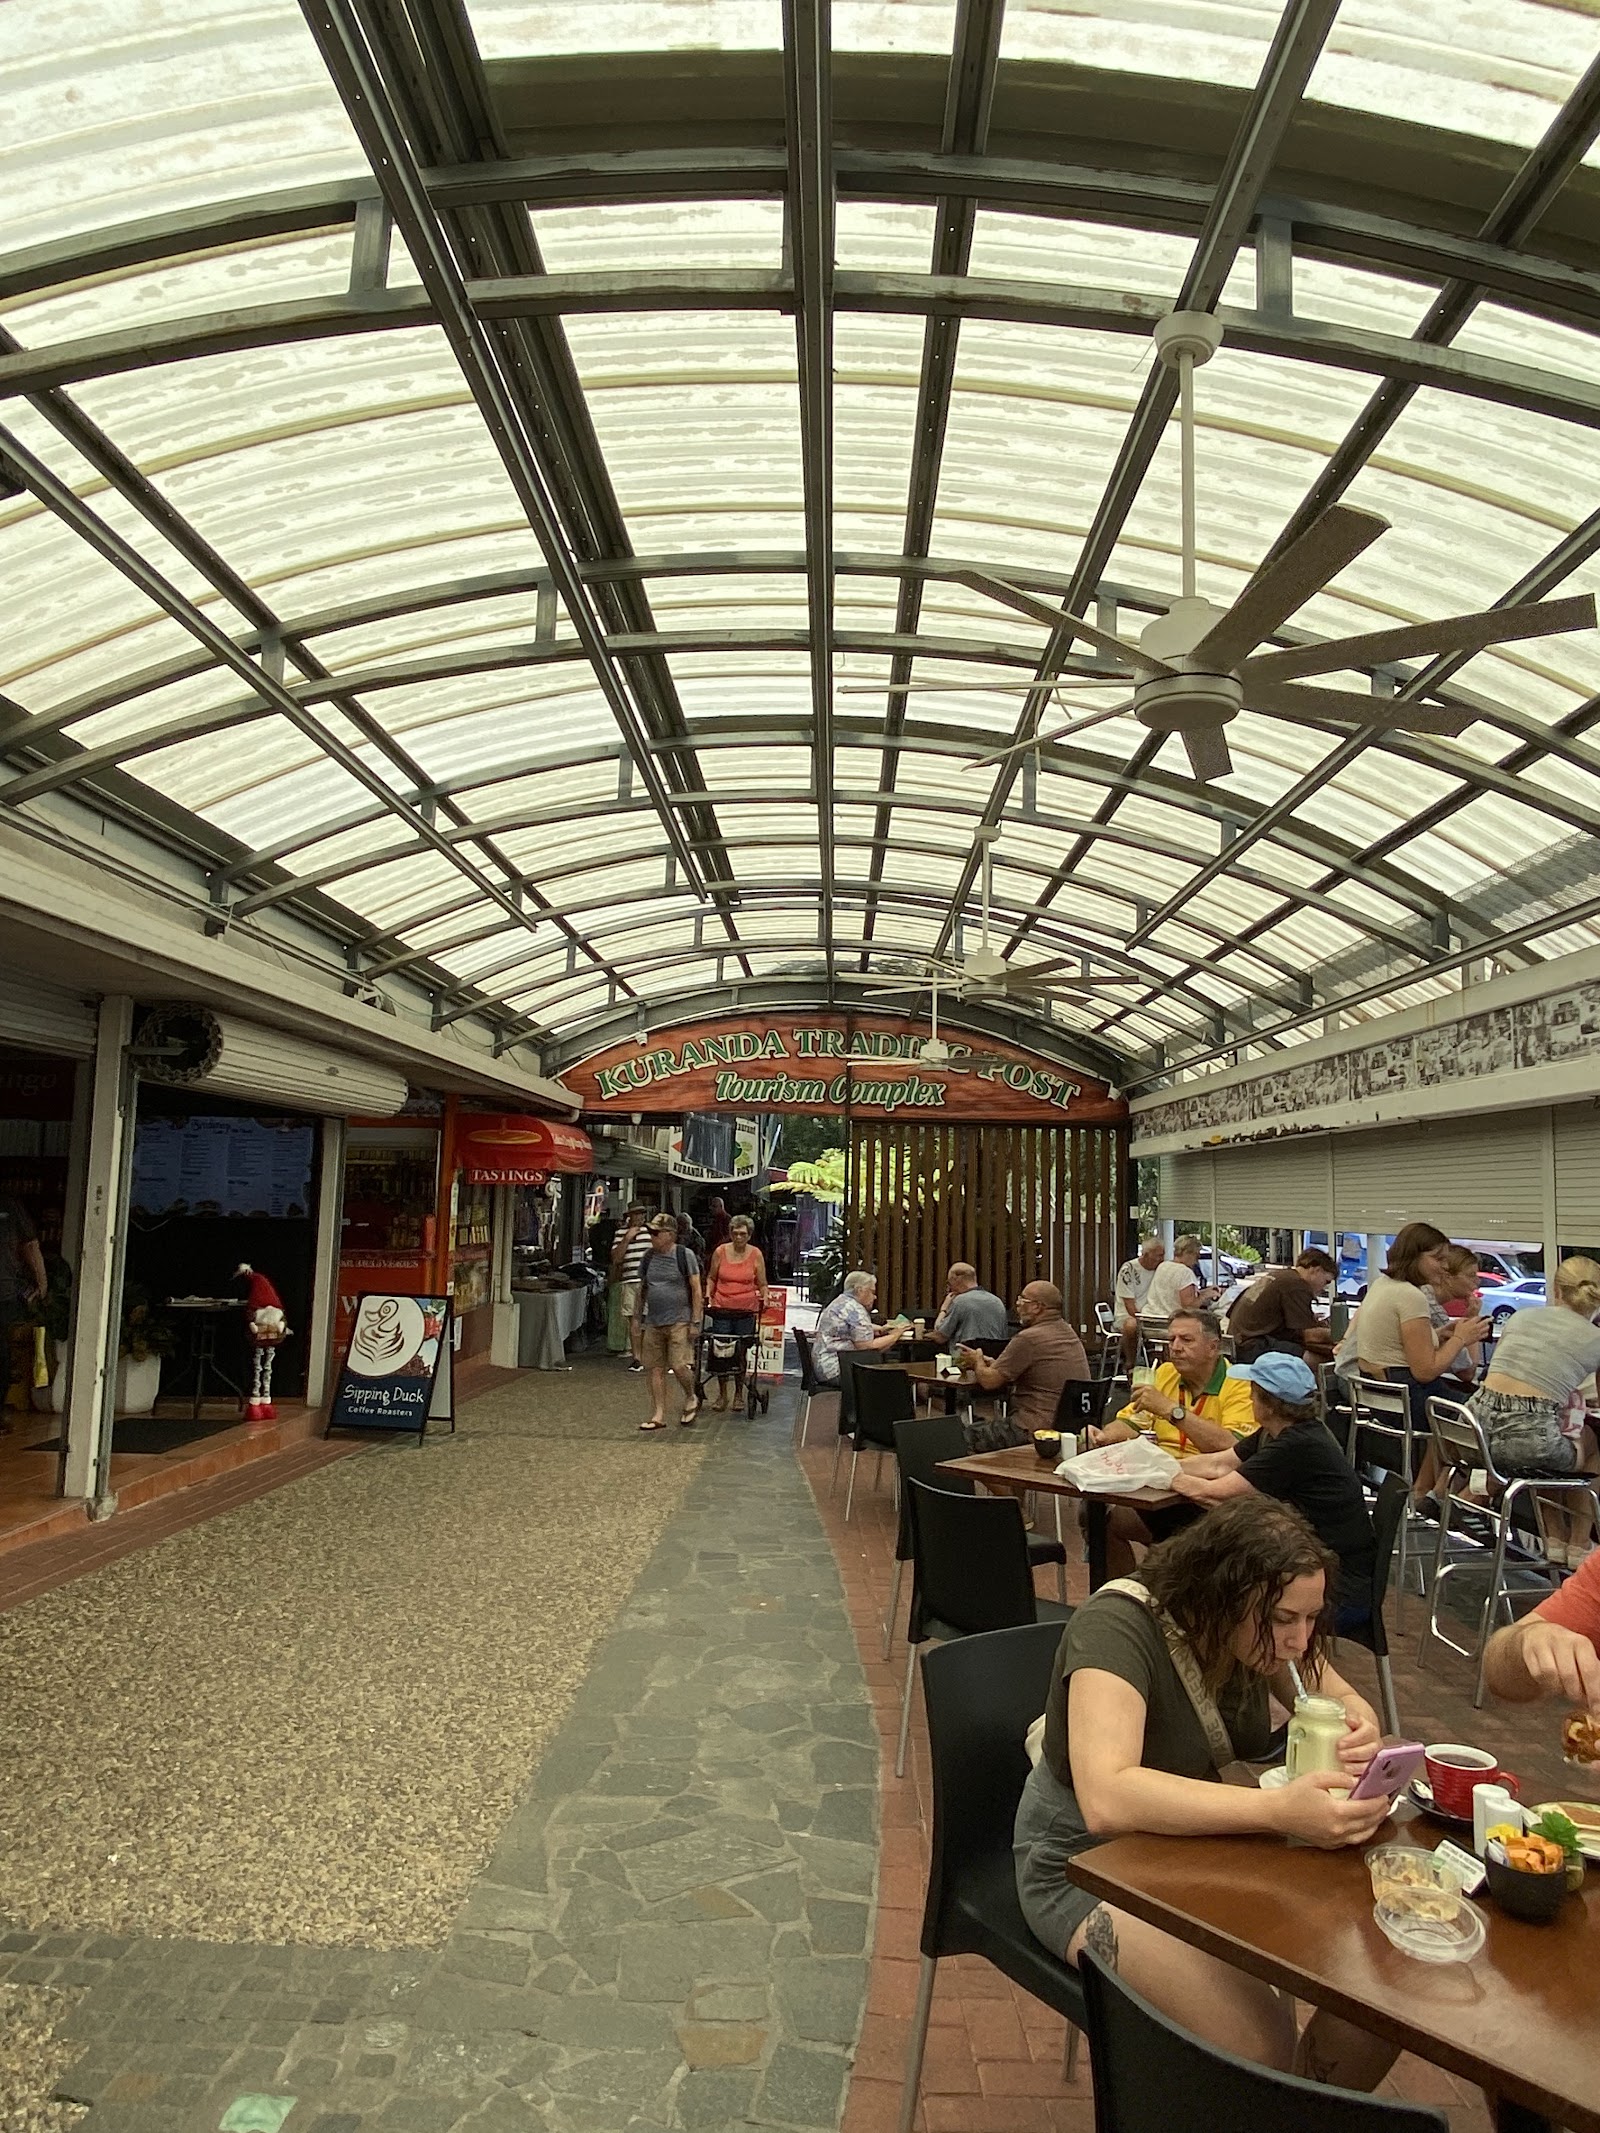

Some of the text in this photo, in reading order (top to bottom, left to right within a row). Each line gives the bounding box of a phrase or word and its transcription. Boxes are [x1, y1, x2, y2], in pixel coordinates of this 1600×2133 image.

[594, 1029, 789, 1101] KURANDA
[977, 1051, 1081, 1110] POST
[715, 1071, 946, 1112] Tourism Complex
[472, 1169, 544, 1181] TASTINGS
[736, 1164, 755, 1178] POST
[343, 1384, 424, 1406] Sipping Duck
[1081, 1392, 1091, 1413] 5
[347, 1406, 413, 1417] Coffee Roasters
